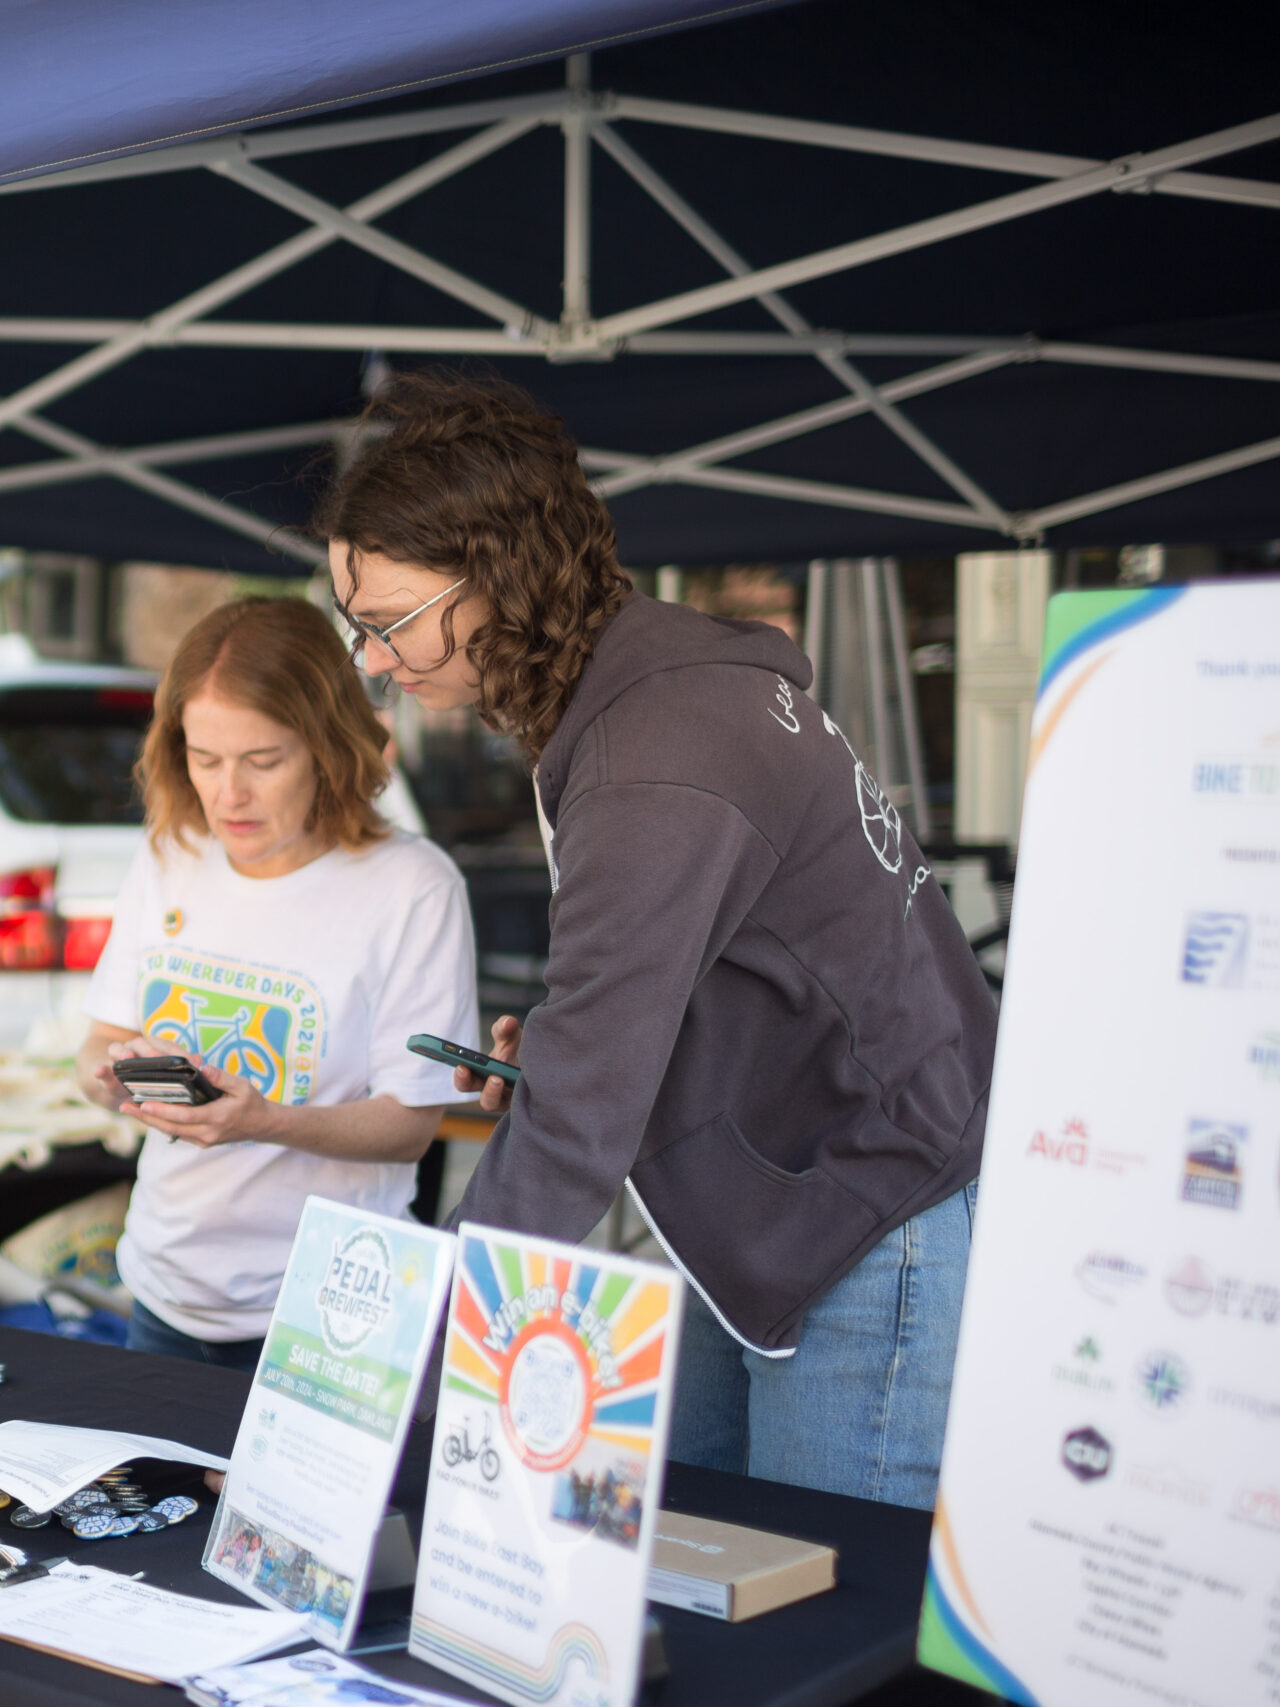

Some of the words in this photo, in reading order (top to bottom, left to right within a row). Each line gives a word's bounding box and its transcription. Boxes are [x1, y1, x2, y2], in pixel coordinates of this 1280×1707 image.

[168, 954, 257, 992] WHEREVER
[260, 977, 306, 1005] DAYS
[297, 1003, 317, 1053] 2024
[318, 1286, 390, 1327] BREWFEST
[331, 1256, 391, 1304] PEDAL
[482, 1296, 525, 1355] Win
[527, 1285, 558, 1311] an
[264, 1367, 281, 1384] JULY
[295, 1380, 314, 1398] 2024
[316, 1388, 338, 1408] SNOW
[288, 1343, 320, 1374] SAVE
[319, 1354, 344, 1383] THE
[342, 1365, 382, 1398] DATE!
[434, 1518, 461, 1542] Join
[520, 1549, 546, 1579] Bay
[429, 1574, 451, 1594] win
[462, 1592, 489, 1612] new
[430, 1547, 455, 1568] and
[456, 1555, 474, 1576] be
[474, 1566, 527, 1599] entered
[528, 1587, 543, 1607] to
